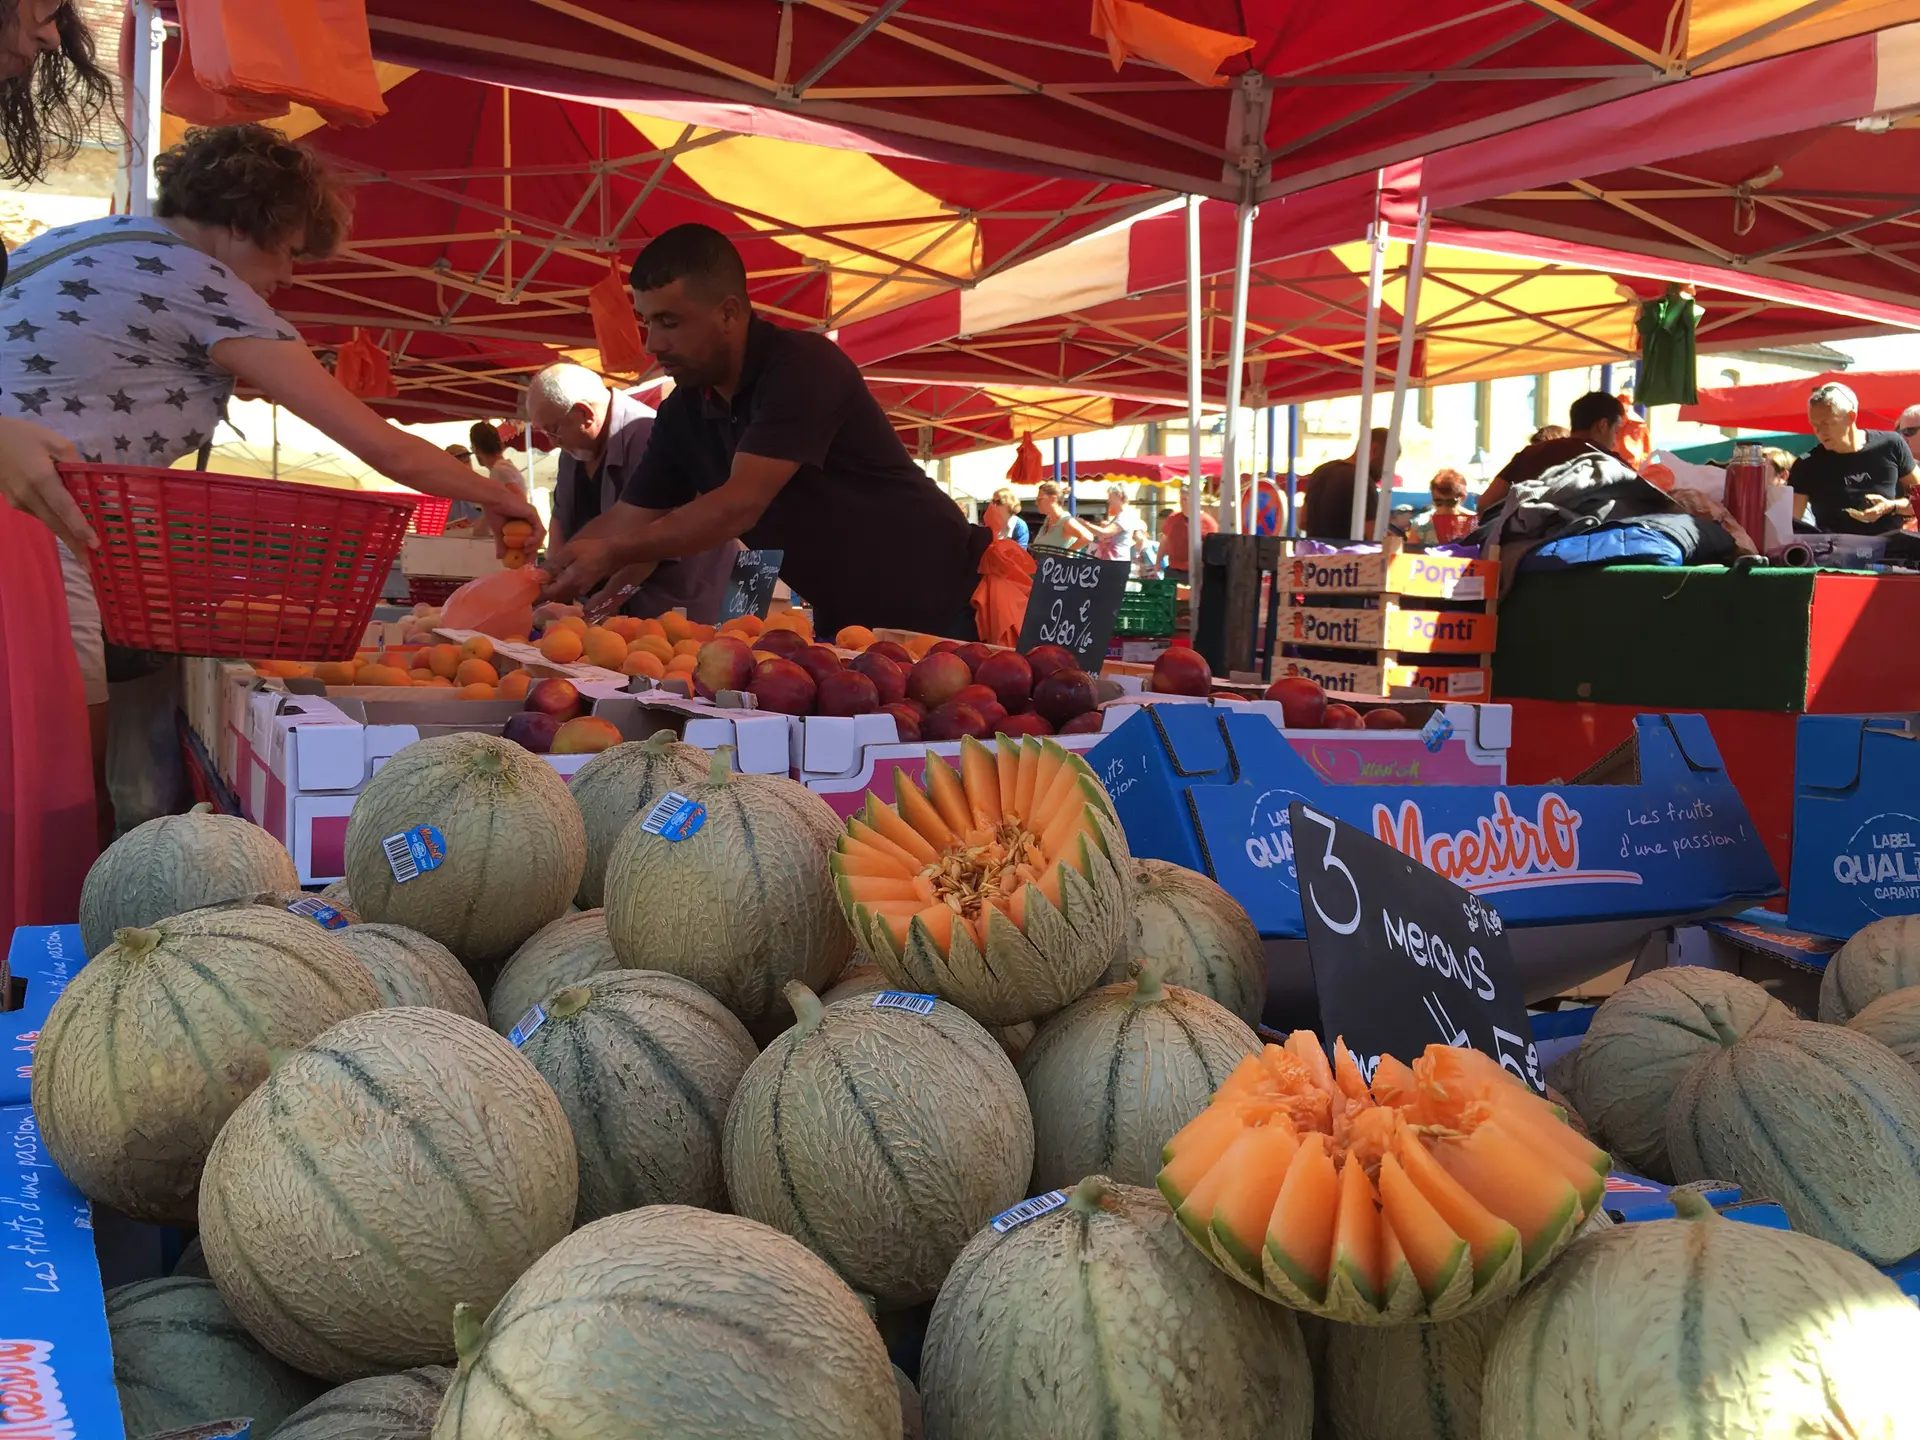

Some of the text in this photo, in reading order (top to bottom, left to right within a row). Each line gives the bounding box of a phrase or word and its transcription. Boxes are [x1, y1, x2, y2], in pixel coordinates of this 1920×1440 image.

[1306, 561, 1360, 588] Ponti
[1305, 613, 1359, 643] Ponti
[1408, 615, 1474, 640] Ponti
[1407, 671, 1449, 694] Pon
[1627, 799, 1714, 826] Les fruits
[1245, 830, 1295, 869] QUA
[1620, 832, 1667, 858] d'une
[1672, 831, 1736, 859] passion
[1872, 832, 1917, 849] LABEL
[1303, 806, 1361, 935] 3
[6, 1114, 52, 1168] passion
[22, 1261, 60, 1294] Les
